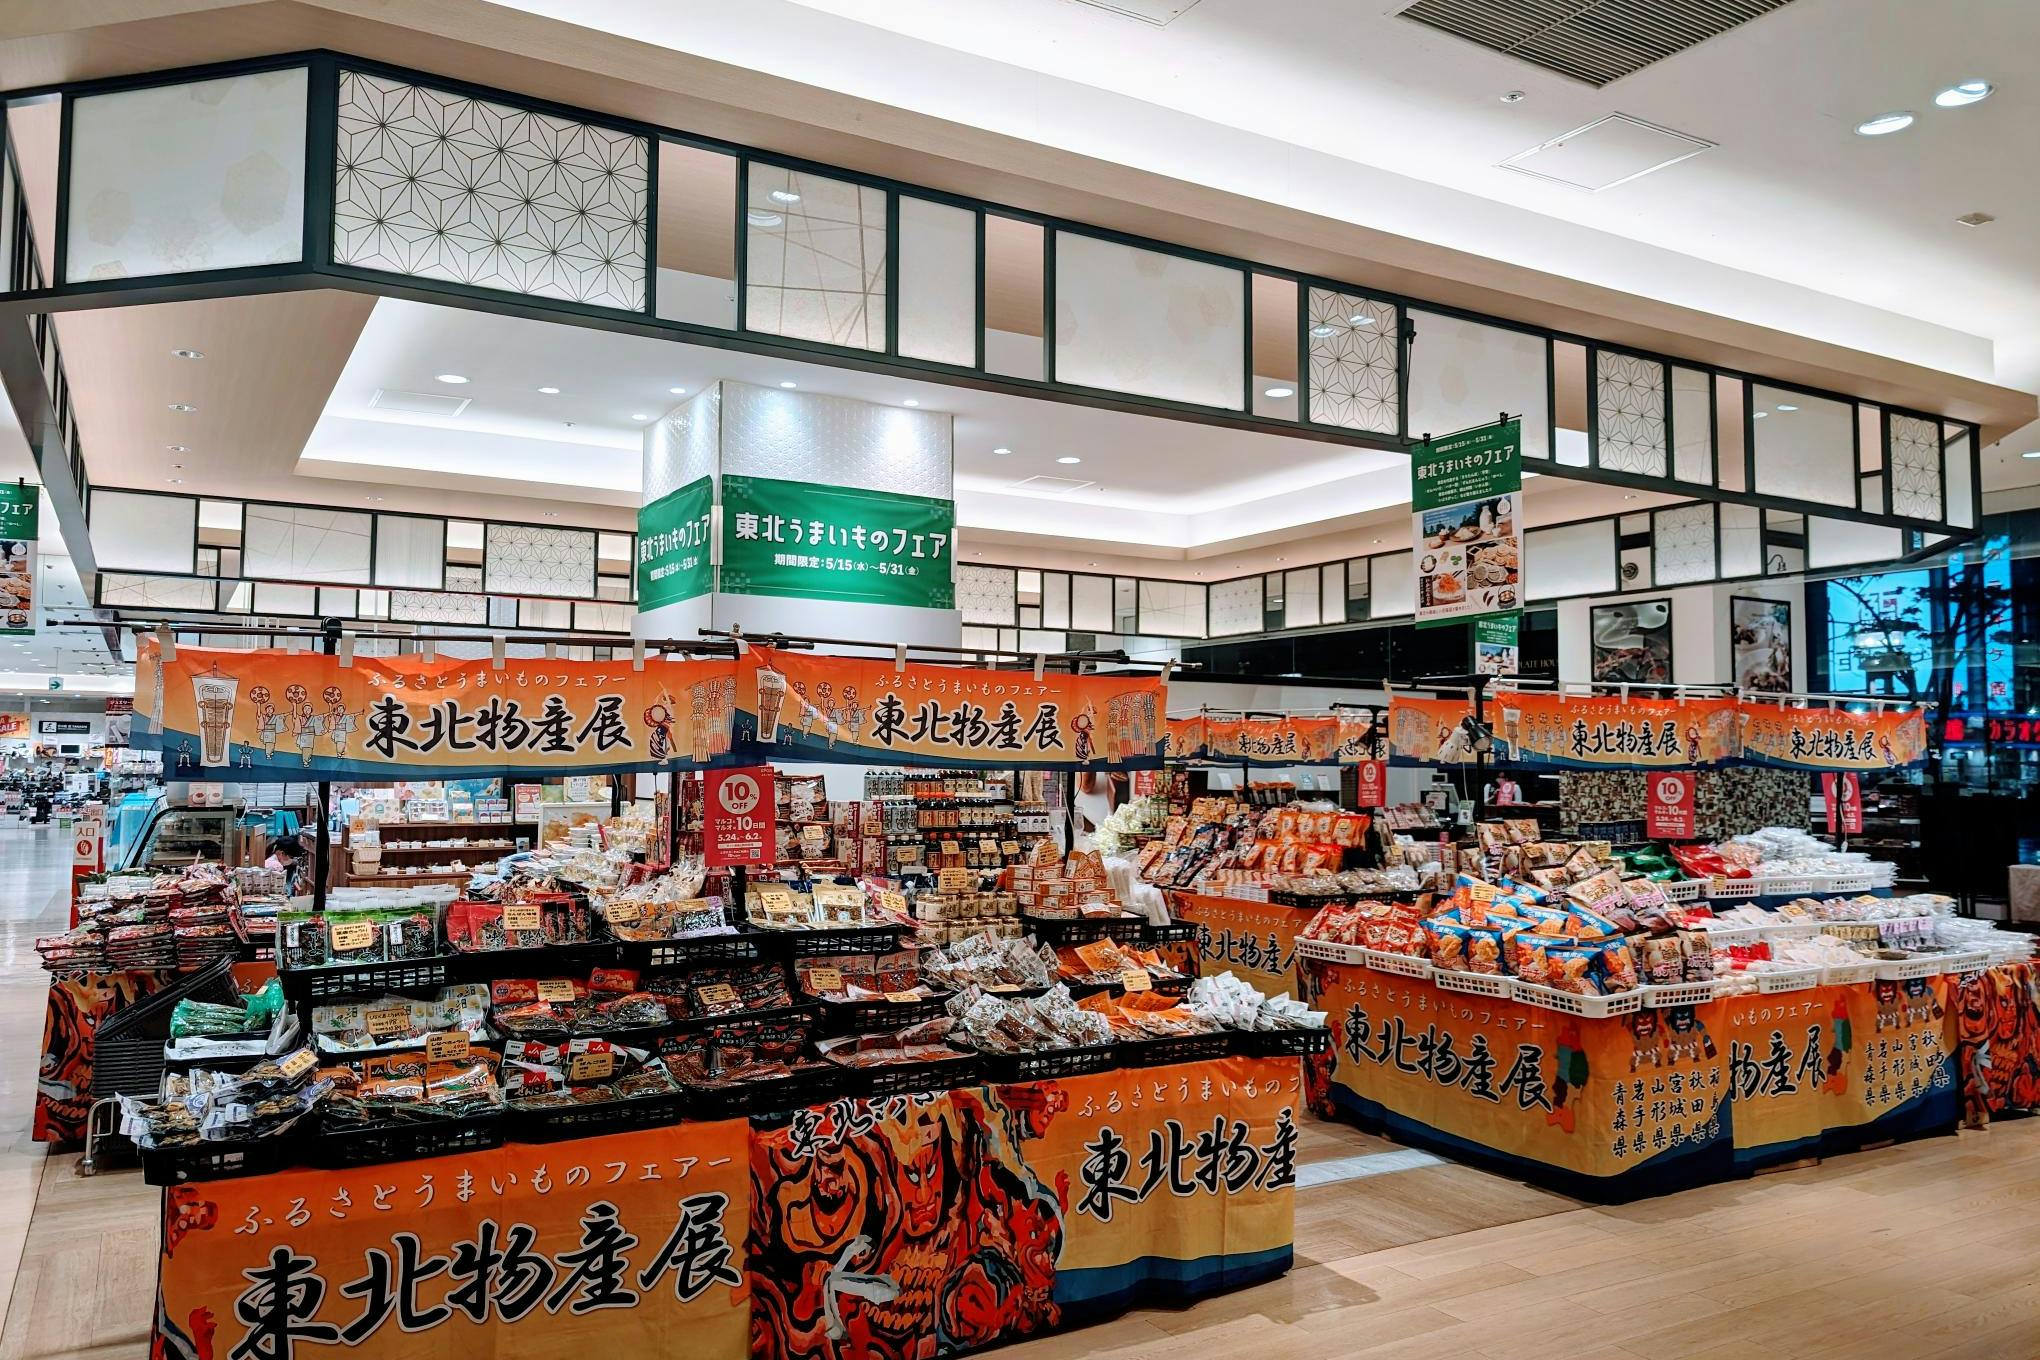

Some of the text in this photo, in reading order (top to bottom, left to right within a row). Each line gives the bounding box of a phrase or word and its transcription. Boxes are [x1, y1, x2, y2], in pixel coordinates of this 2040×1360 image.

[1417, 445, 1514, 480] 東北うまいものフェア
[641, 514, 710, 564] 東北うまいものフェア
[735, 512, 947, 559] 東北うまいものフェア
[368, 669, 627, 690] ふるさとうまいものフェアー
[875, 675, 1062, 696] ふるさとうまいものフェアー
[366, 695, 633, 758] 東北物産展
[871, 693, 1065, 750] 東北物産展
[1570, 721, 1681, 757] 東北物産展
[1788, 729, 1878, 760] 東北物産展
[77, 828, 95, 837] 入口
[732, 802, 748, 810] OFF
[1199, 923, 1299, 976] 東北物産
[1343, 1002, 1554, 1112] 東北物産展
[1893, 1039, 1906, 1099] 山形県
[1612, 1082, 1627, 1158] 青森県
[1632, 1079, 1646, 1153] 岩手県
[1651, 1078, 1666, 1149] 山形県
[1669, 1073, 1687, 1147] 宮城県
[1689, 1071, 1706, 1143] 秋田県
[235, 1155, 733, 1236] ふるさとうまいものフェアー
[228, 1192, 743, 1360] 東北物産展
